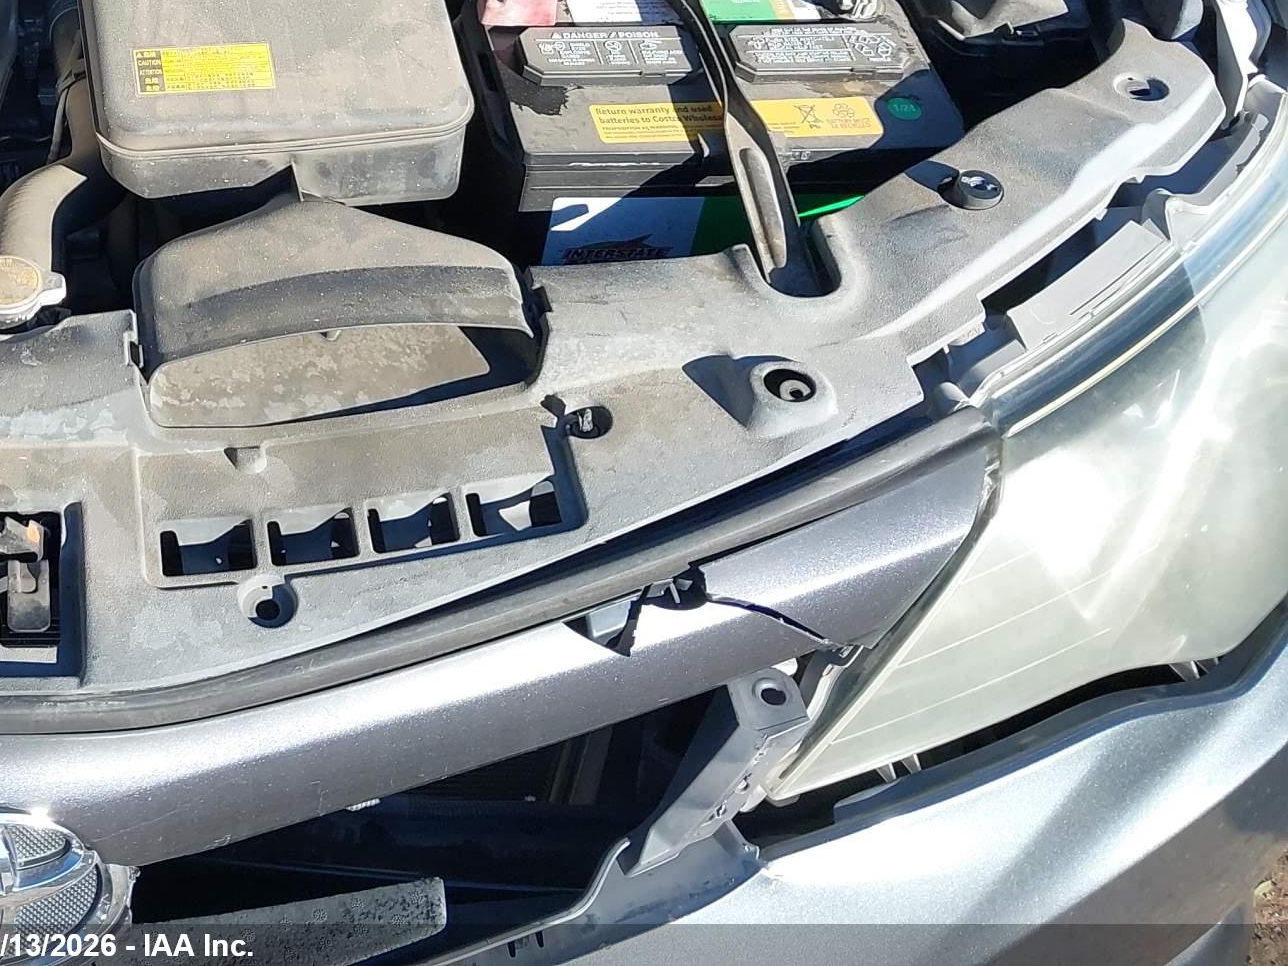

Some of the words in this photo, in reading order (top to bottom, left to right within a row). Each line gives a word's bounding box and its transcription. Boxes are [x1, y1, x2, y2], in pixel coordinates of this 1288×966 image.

[595, 107, 627, 115] Return
[628, 106, 670, 115] warranty
[691, 105, 713, 113] used
[599, 116, 641, 124] batteries
[566, 248, 669, 260] INTERSTATE
